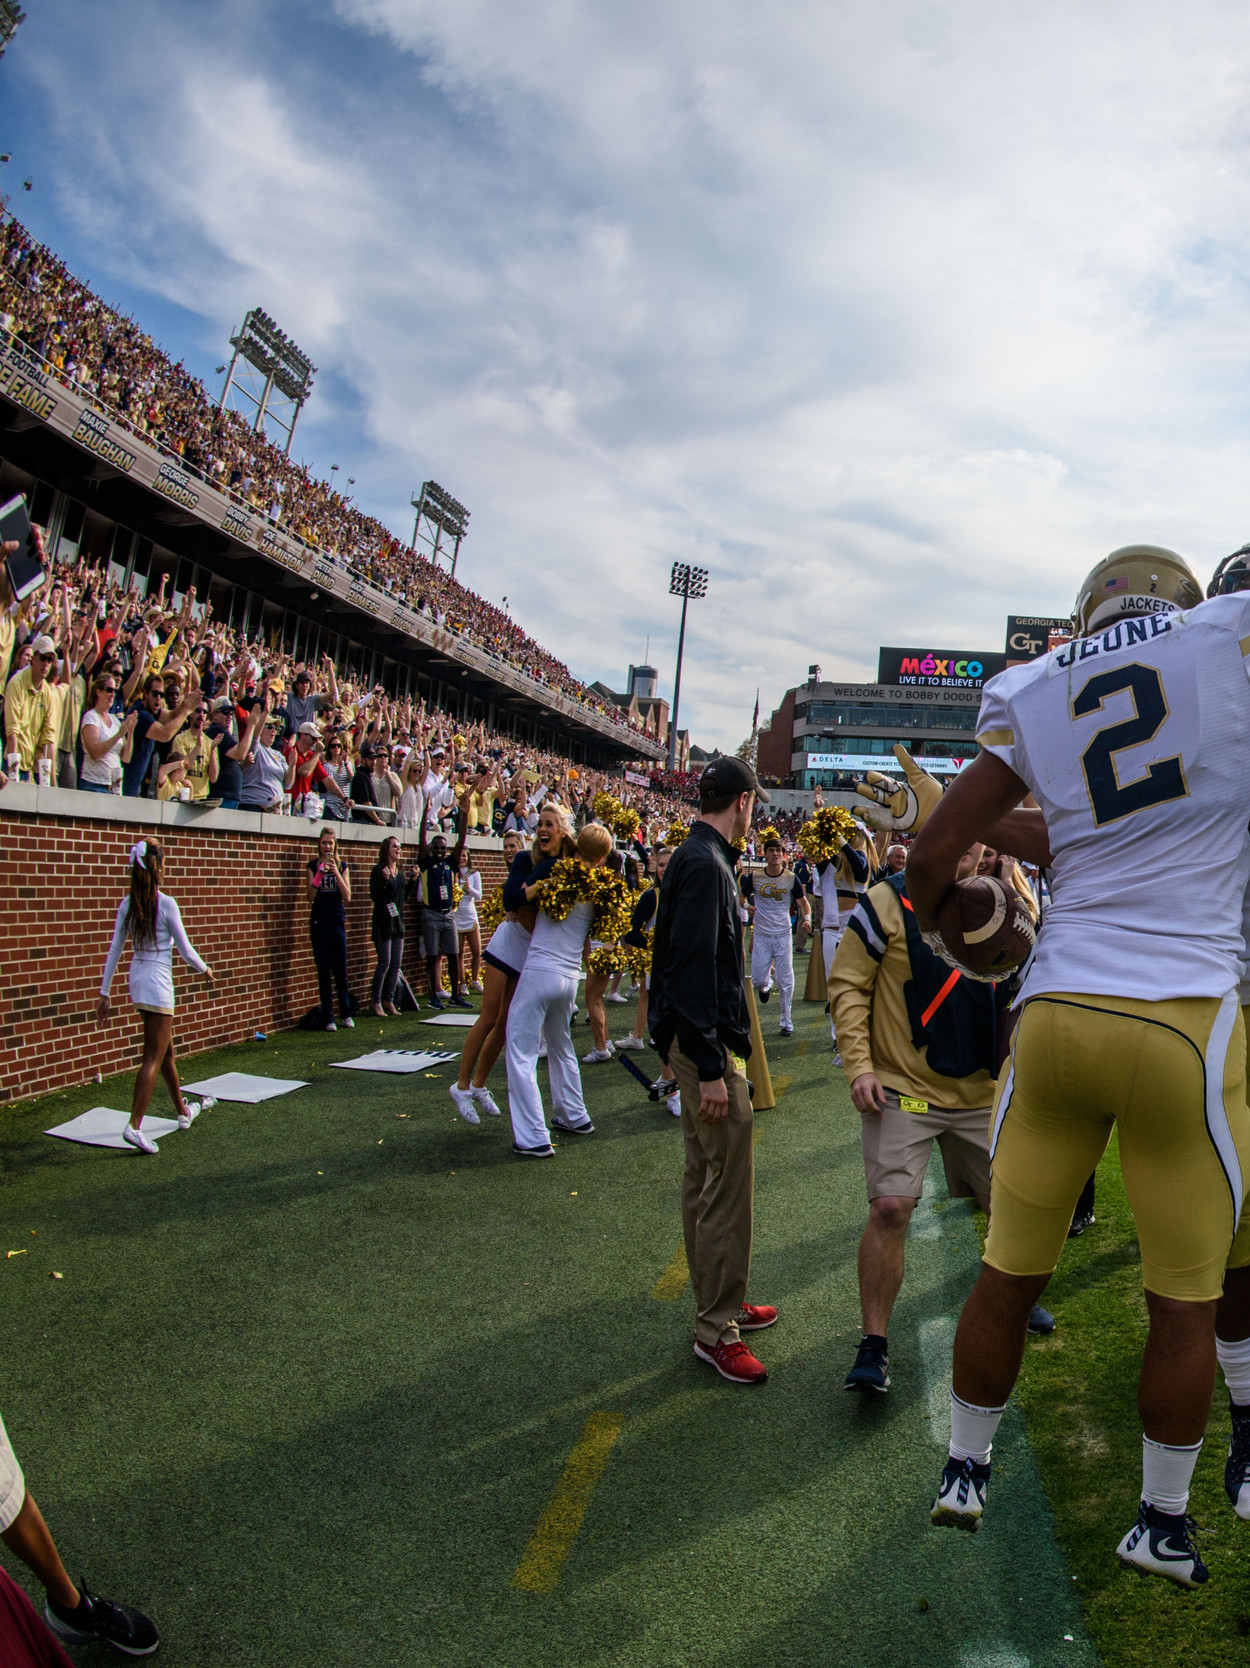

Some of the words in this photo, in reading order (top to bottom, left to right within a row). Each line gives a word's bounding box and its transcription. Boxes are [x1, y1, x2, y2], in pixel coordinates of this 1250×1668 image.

[7, 351, 49, 388] FOOTBALL
[6, 374, 58, 421] FAME
[79, 408, 110, 436] MAXIE
[72, 421, 137, 473] BAUGHAN
[159, 463, 190, 487] GEORGE
[152, 475, 199, 510] MORRIS
[225, 505, 250, 525] BOBBY
[220, 517, 253, 542] DAVIS
[262, 529, 277, 542] JOE
[258, 538, 304, 573] HAMILTON
[311, 569, 336, 590] PUND
[1150, 583, 1157, 594] 2
[345, 590, 380, 614] FLOWERS
[1120, 598, 1175, 612] JACKETS
[1016, 617, 1054, 627] GEORGIA
[1057, 620, 1073, 628] TEC
[1056, 612, 1172, 668] JEUNE
[899, 676, 917, 685] LIVE
[918, 676, 926, 685] IT
[927, 677, 940, 686] TO
[941, 677, 973, 687] BELIEVE
[975, 679, 983, 687] IT
[834, 687, 885, 698] WELCOME
[889, 689, 902, 699] TO
[906, 690, 940, 700] BOBBY
[943, 692, 972, 701] DODD
[1071, 660, 1191, 829] 2
